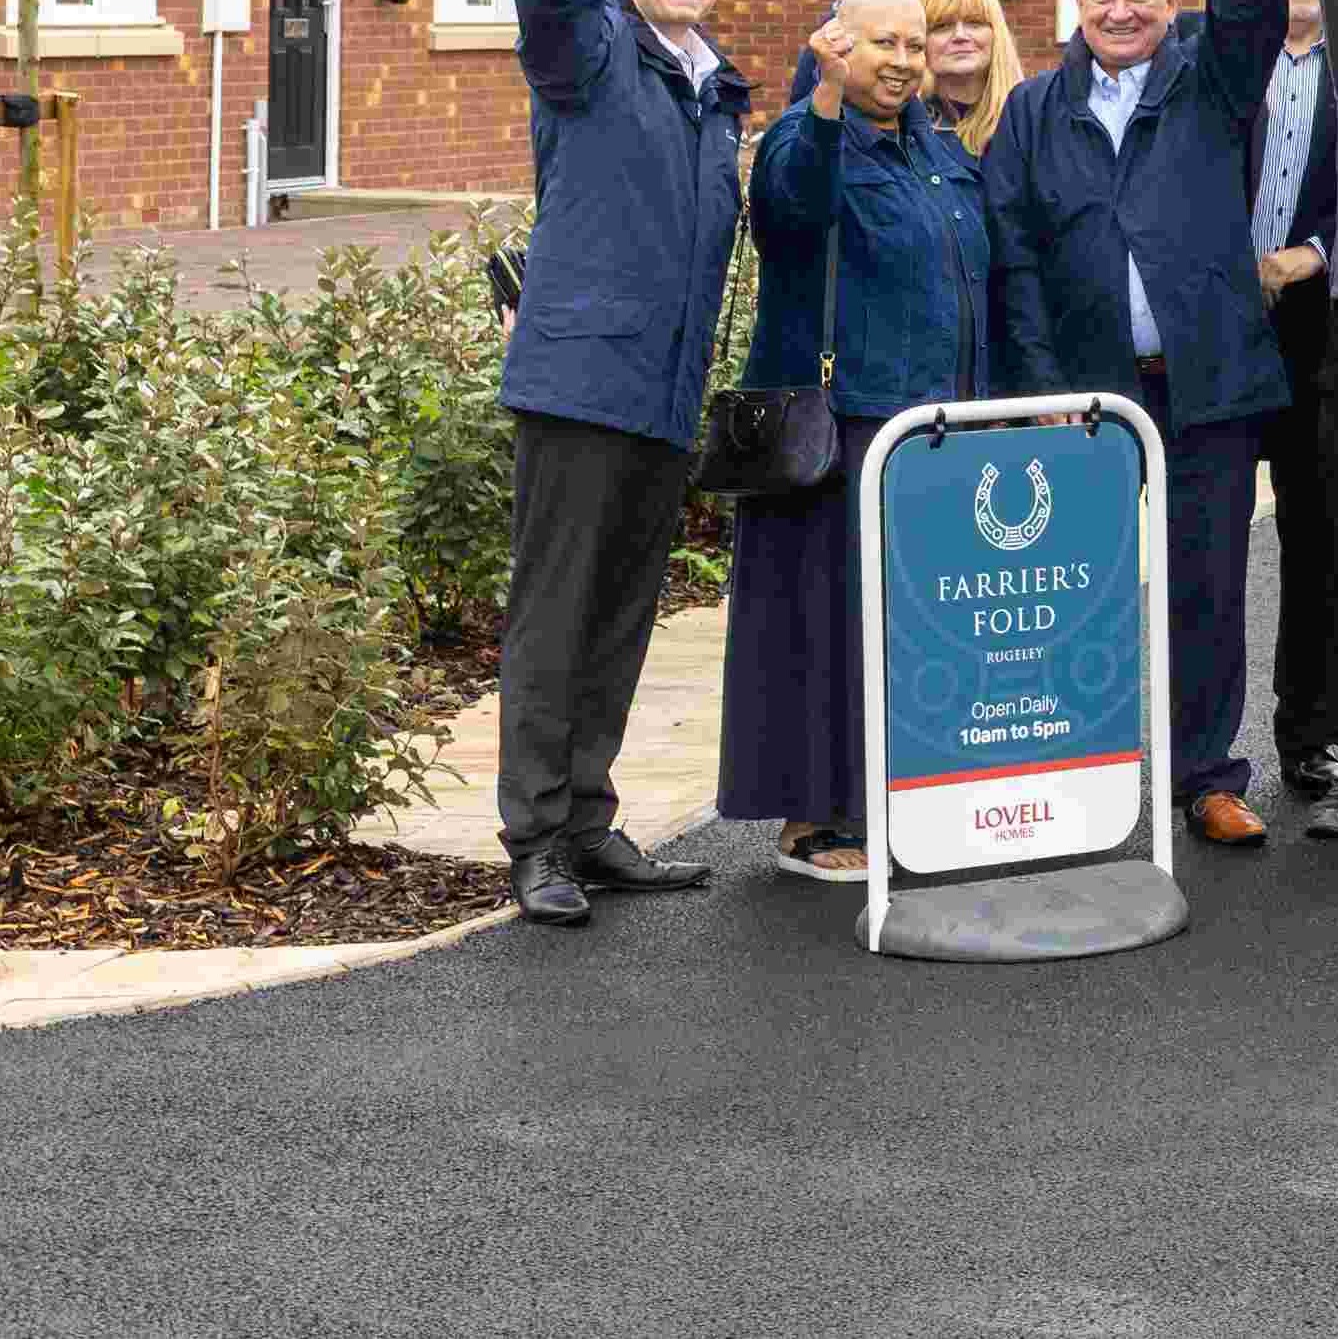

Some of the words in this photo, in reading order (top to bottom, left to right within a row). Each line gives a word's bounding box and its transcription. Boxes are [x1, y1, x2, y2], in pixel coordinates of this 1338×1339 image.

[938, 563, 1090, 601] FARRIER'S
[974, 605, 1055, 636] FOLD
[986, 647, 1045, 663] RUGELEY
[971, 701, 1016, 722] Open
[1020, 694, 1058, 715] Daily
[960, 727, 1007, 746] 10am
[1011, 723, 1029, 740] to
[1033, 720, 1070, 740] 5pm
[975, 801, 1054, 829] LOVELL
[996, 827, 1036, 843] HOMES
